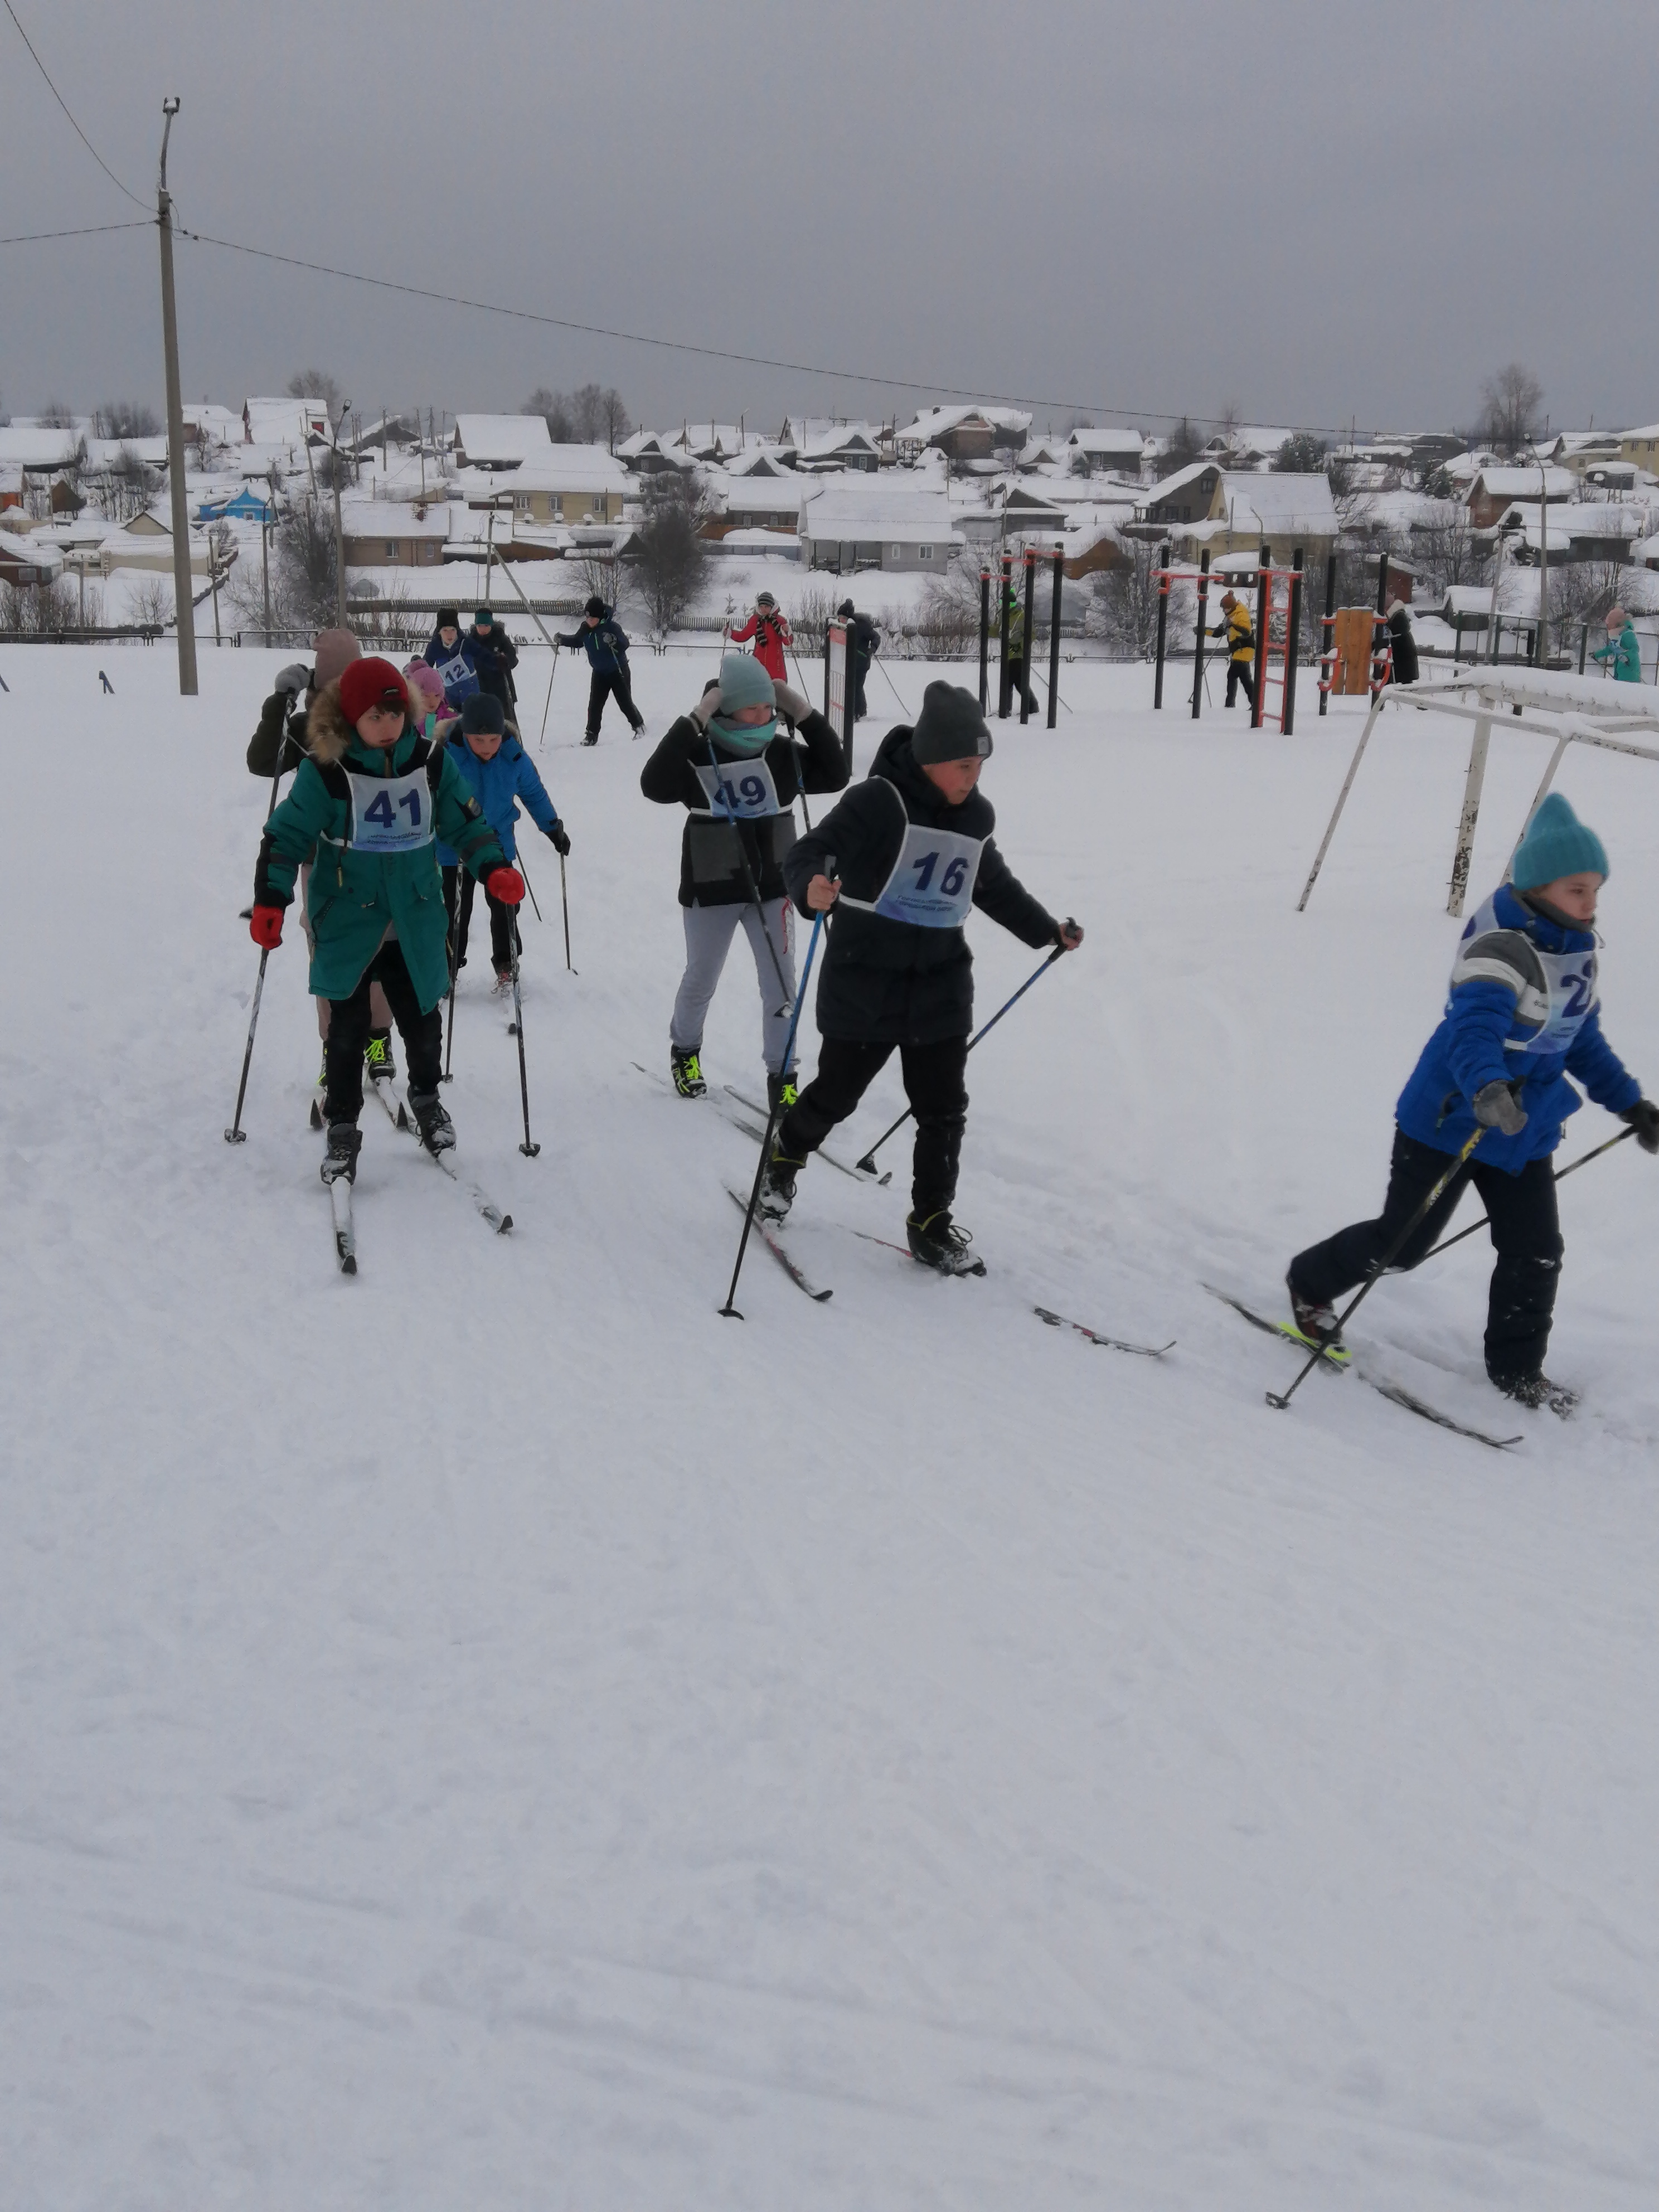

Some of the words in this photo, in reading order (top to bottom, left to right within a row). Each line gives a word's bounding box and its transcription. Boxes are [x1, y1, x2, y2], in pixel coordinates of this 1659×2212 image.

[445, 664, 465, 683] 12
[364, 788, 422, 829] 41
[714, 775, 767, 809] 49
[912, 851, 969, 898] 16
[1560, 959, 1593, 1018] 2
